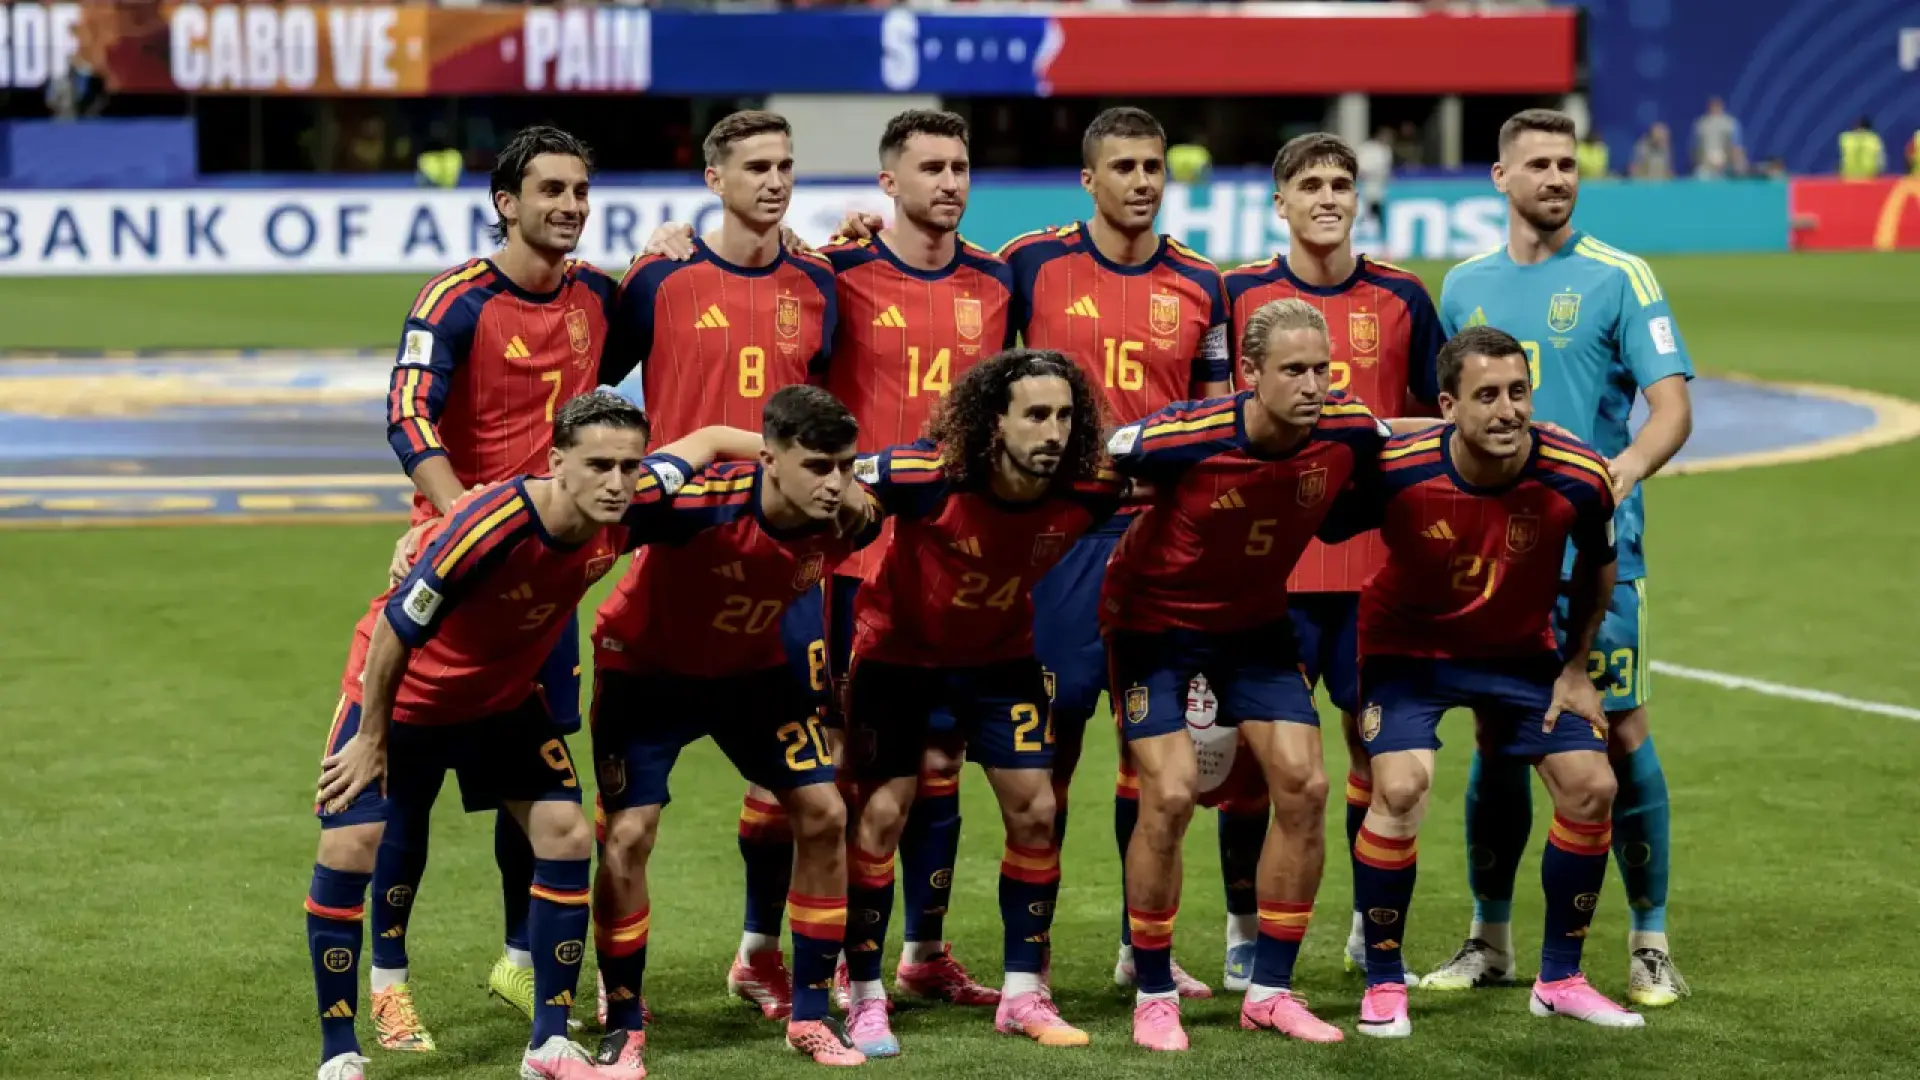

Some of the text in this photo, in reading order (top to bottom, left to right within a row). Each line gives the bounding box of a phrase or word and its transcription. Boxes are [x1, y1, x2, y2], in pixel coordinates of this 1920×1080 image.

[0, 3, 82, 88] DE
[170, 3, 317, 91] CABO
[266, 202, 369, 258] OF
[739, 346, 765, 398] 8
[908, 346, 951, 397] 14
[1103, 338, 1144, 391] 16
[541, 371, 562, 412] 7
[1244, 518, 1277, 556] 5
[952, 572, 1021, 612] 24
[1452, 554, 1498, 600] 21
[519, 602, 557, 631] 9
[712, 595, 783, 635] 20
[808, 638, 826, 690] 8
[1588, 648, 1633, 698] 23
[540, 738, 576, 787] 9
[777, 714, 832, 772] 20
